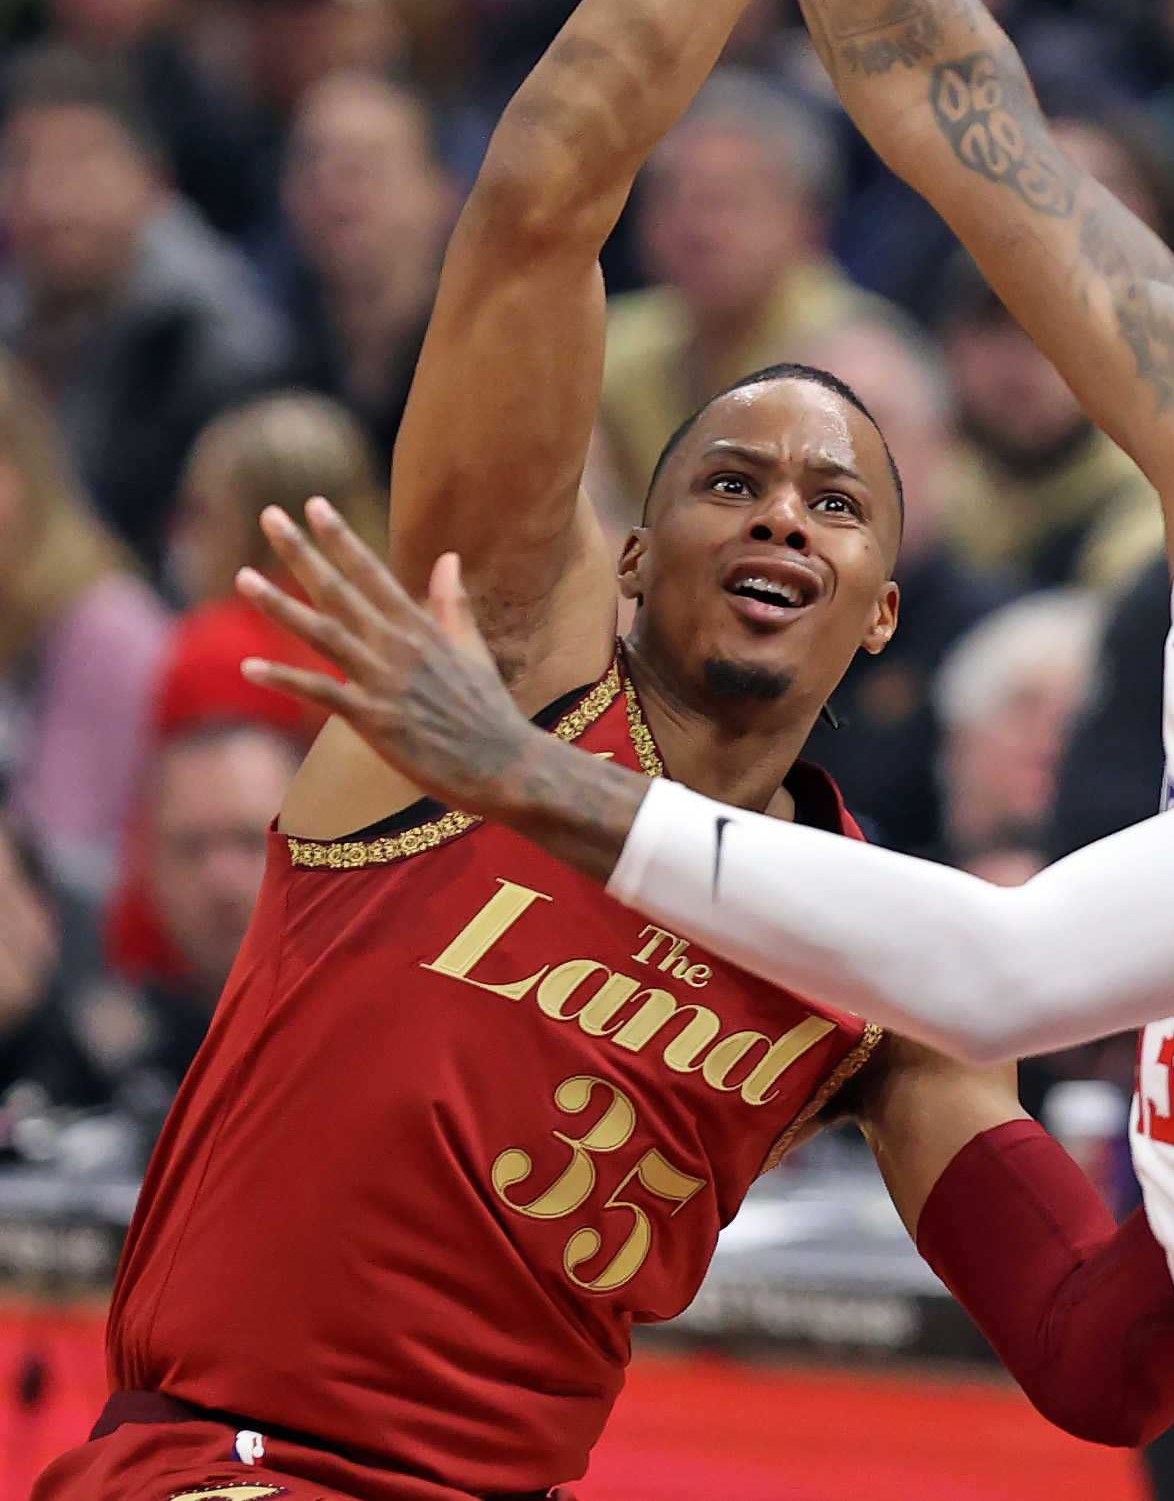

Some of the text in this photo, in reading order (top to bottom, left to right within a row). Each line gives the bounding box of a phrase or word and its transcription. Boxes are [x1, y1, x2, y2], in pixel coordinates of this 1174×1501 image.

[419, 877, 837, 1106] Land
[631, 923, 714, 988] The
[491, 1074, 707, 1292] 35
